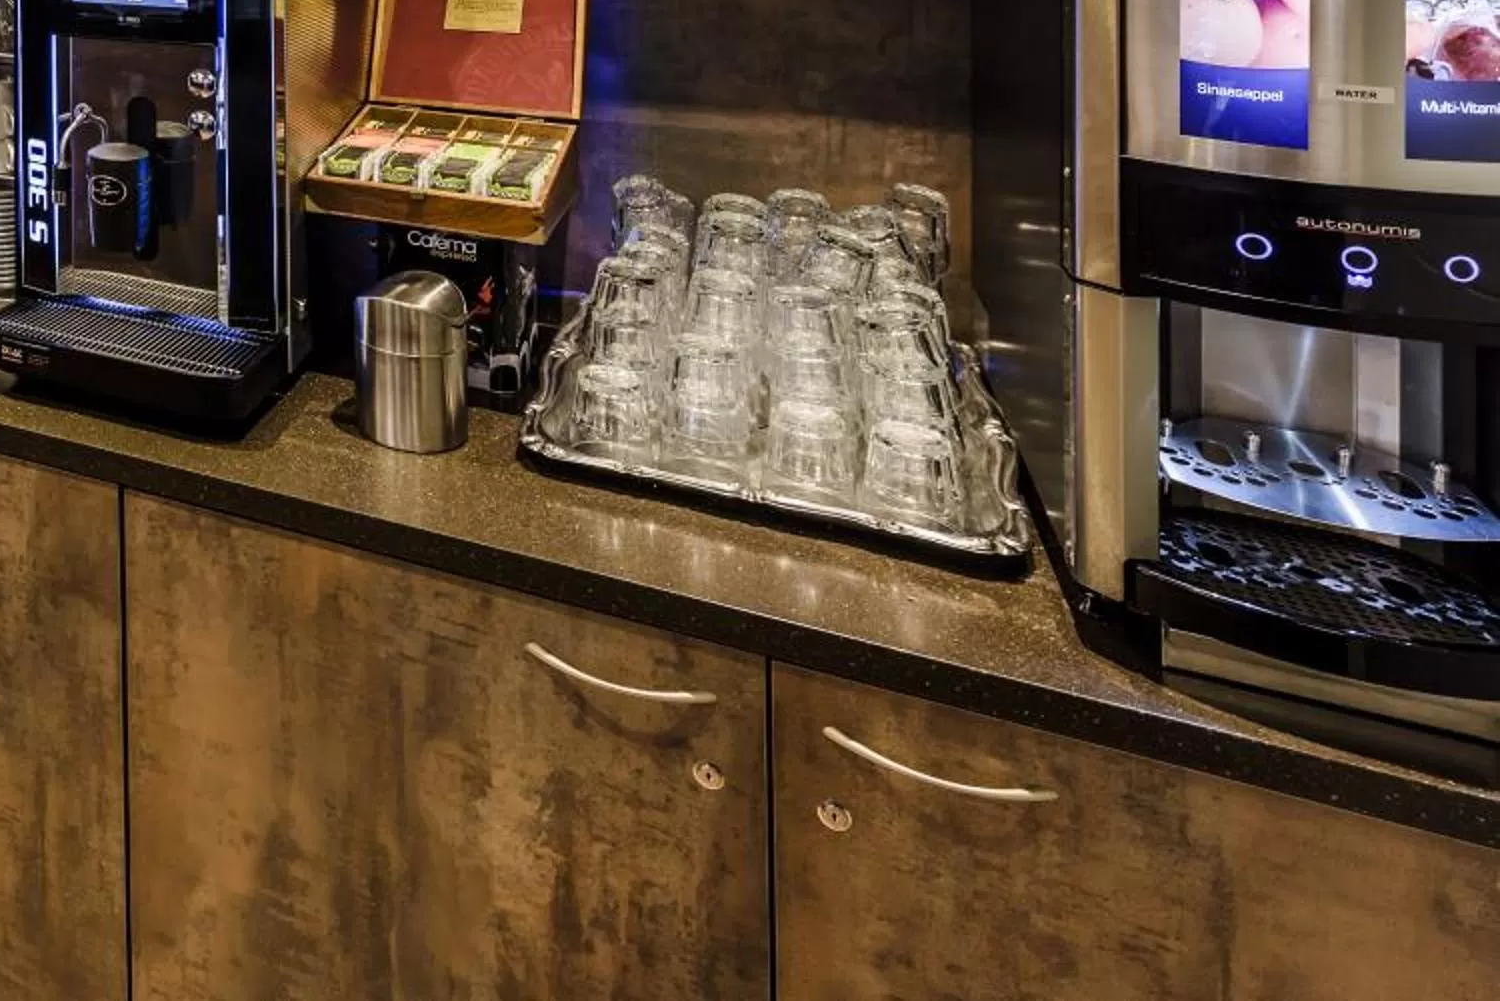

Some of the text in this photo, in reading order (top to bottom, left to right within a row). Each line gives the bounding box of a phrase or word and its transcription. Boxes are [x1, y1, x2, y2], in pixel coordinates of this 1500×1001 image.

[27, 138, 49, 244] S 300
[1296, 216, 1421, 240] autonumis
